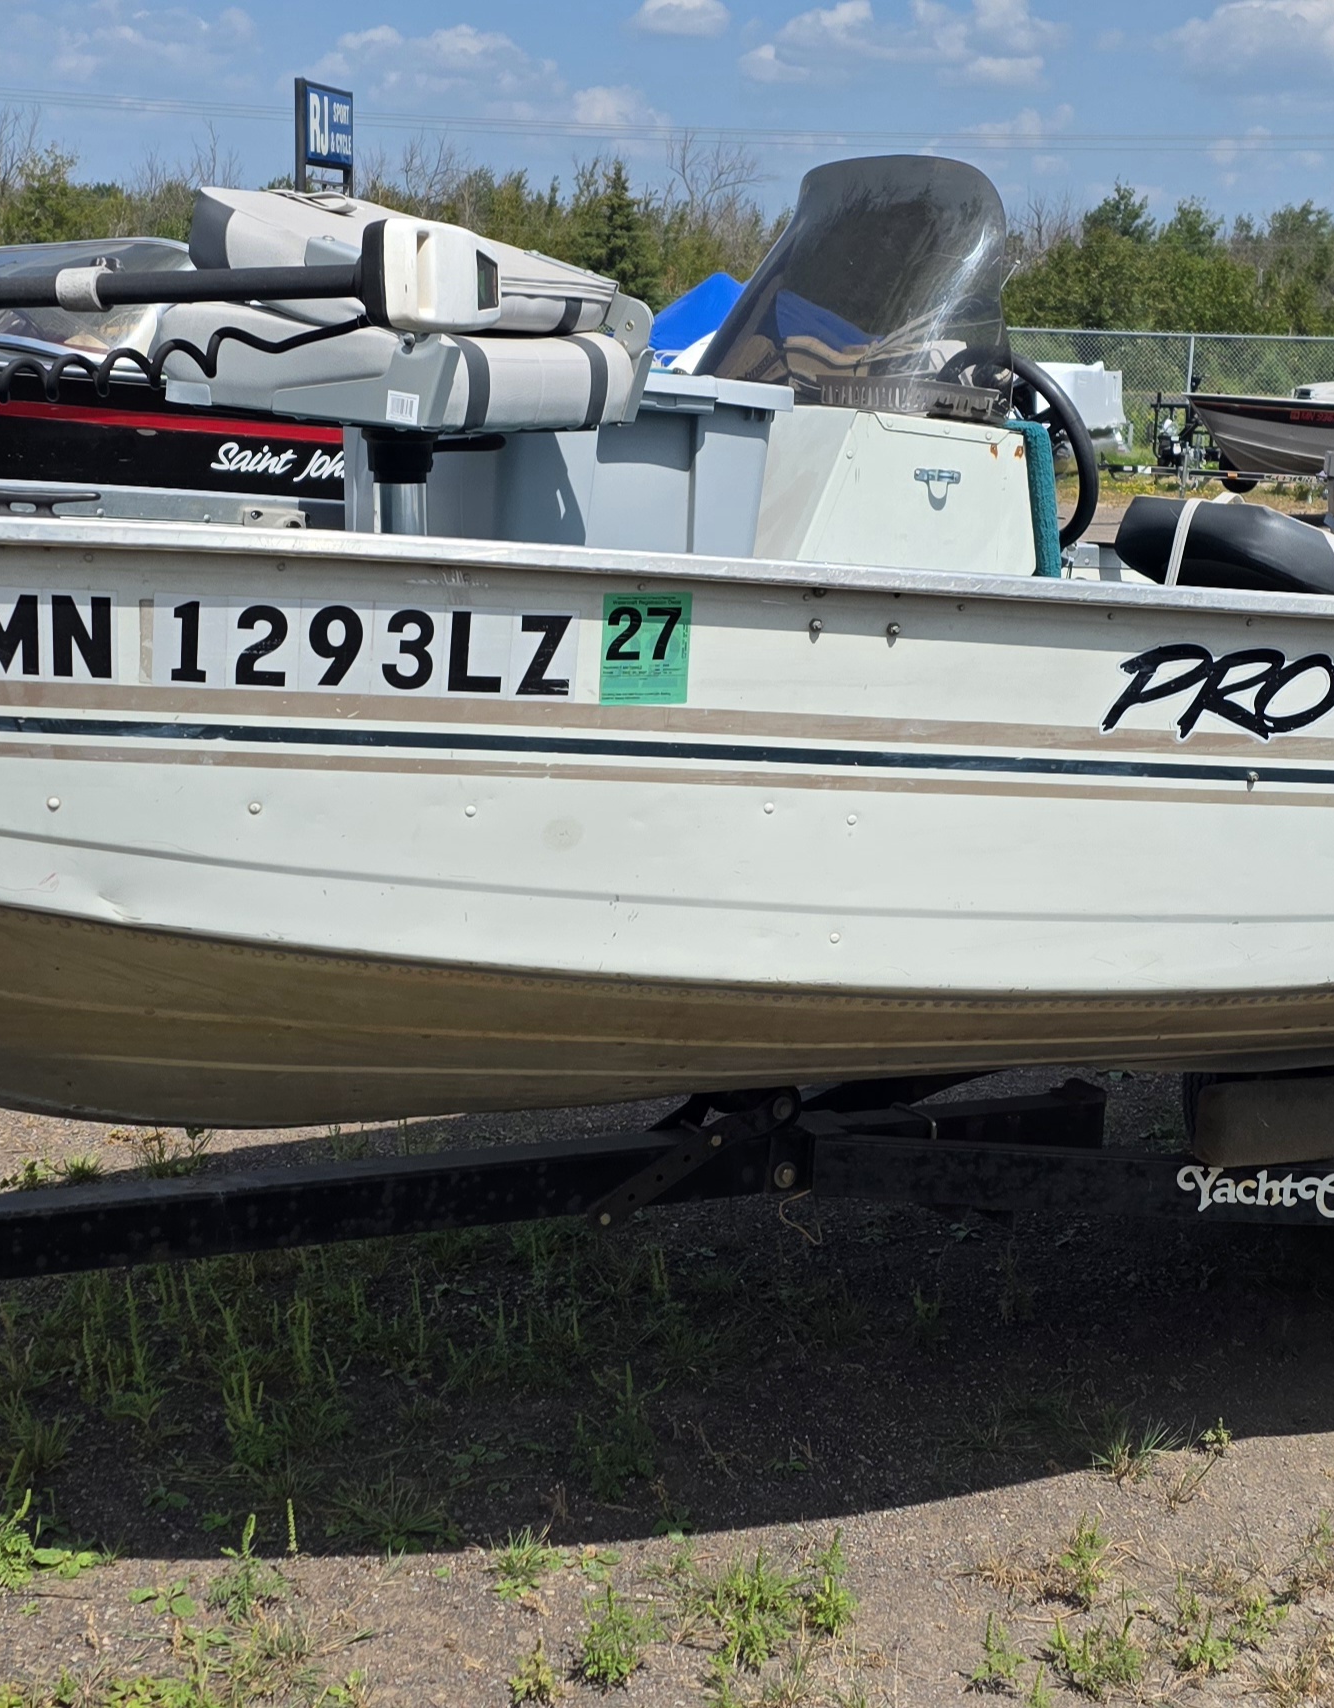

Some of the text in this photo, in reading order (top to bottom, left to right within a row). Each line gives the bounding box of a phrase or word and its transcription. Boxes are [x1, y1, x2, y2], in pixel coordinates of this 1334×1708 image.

[309, 92, 329, 156] RJ
[332, 102, 350, 125] SPORT
[330, 131, 352, 155] & CYCLE
[210, 441, 345, 482] Saint Joh
[605, 606, 683, 661] 27
